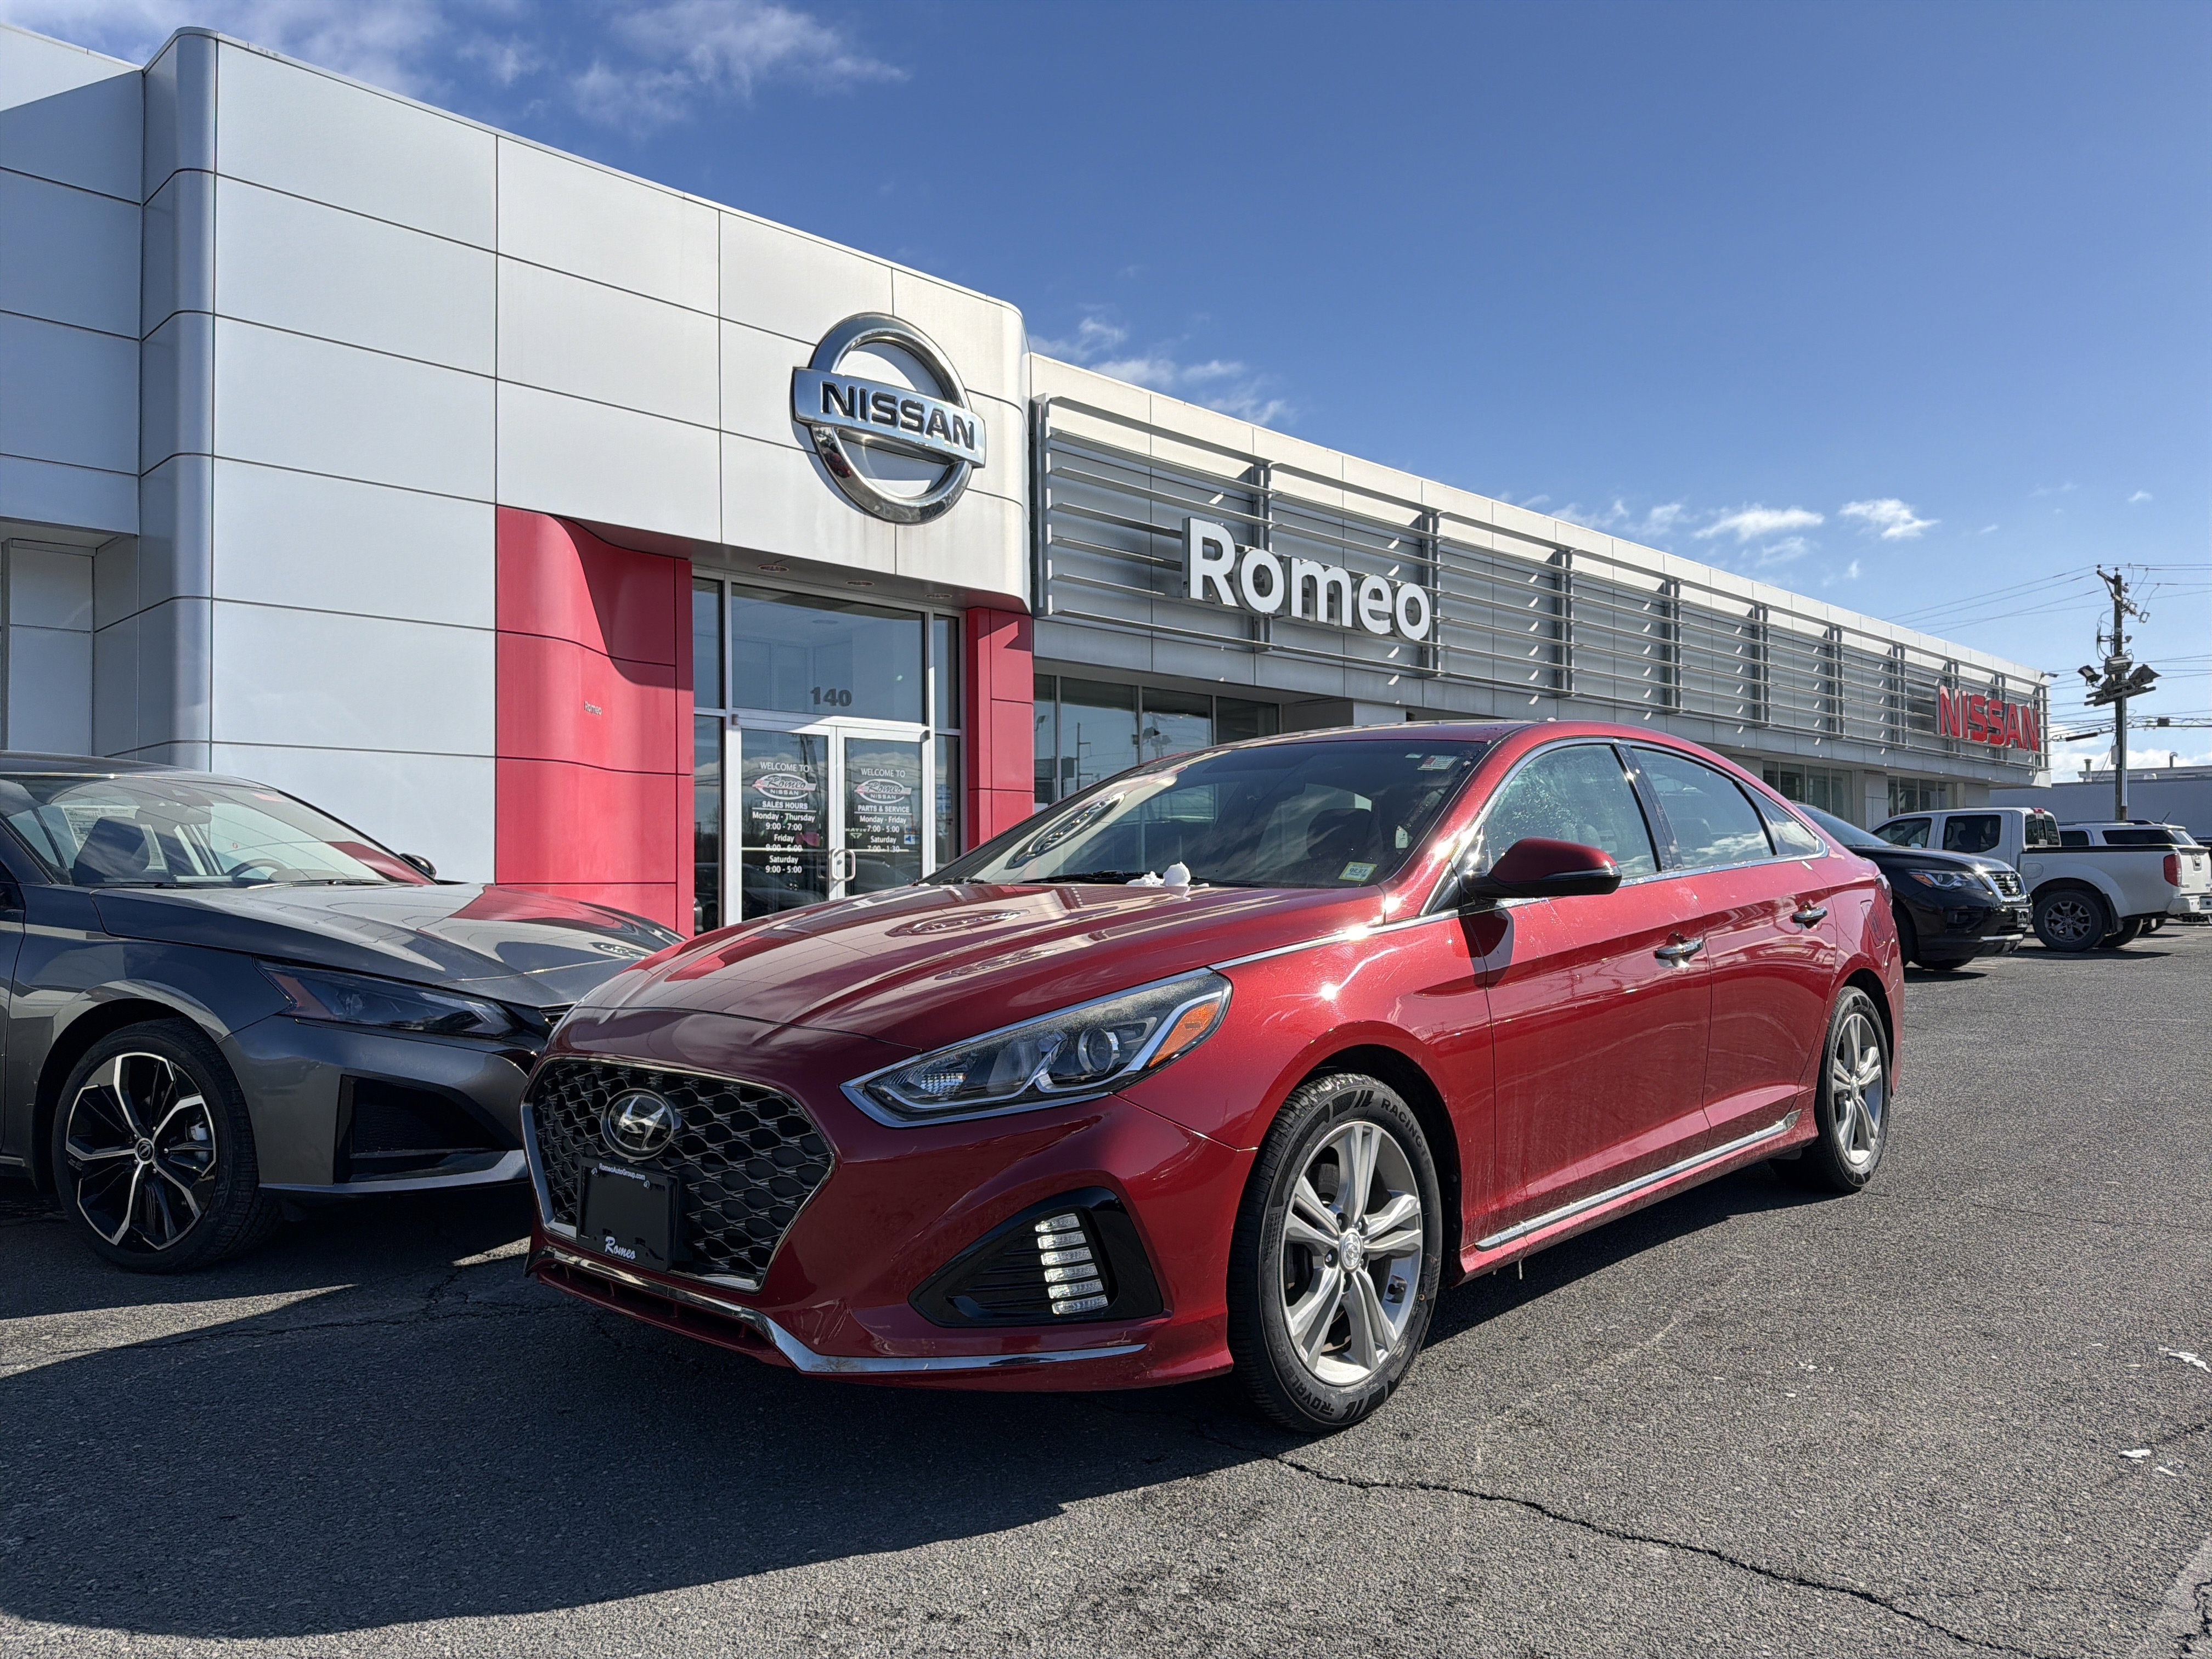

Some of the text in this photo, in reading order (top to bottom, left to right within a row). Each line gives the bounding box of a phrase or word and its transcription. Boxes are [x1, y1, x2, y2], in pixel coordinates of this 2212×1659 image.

[821, 381, 976, 453] NISSAN
[1183, 517, 1431, 641] Romeo
[810, 686, 852, 707] 140
[584, 700, 602, 715] Romeo
[1938, 684, 2039, 753] NISSAN
[760, 761, 810, 773] WELCOME TO
[861, 768, 894, 777] WELCOME
[764, 775, 806, 789] Romeo
[867, 781, 902, 793] Romeo
[762, 800, 808, 810] SALES HOURS
[752, 811, 779, 821] Monday
[785, 813, 815, 823] Thursday
[860, 815, 884, 824] Monday
[889, 816, 906, 825] Friday
[774, 834, 795, 843] Friday
[870, 836, 897, 844] Saturday
[769, 855, 799, 865] Saturday
[605, 1236, 636, 1260] Romeo
